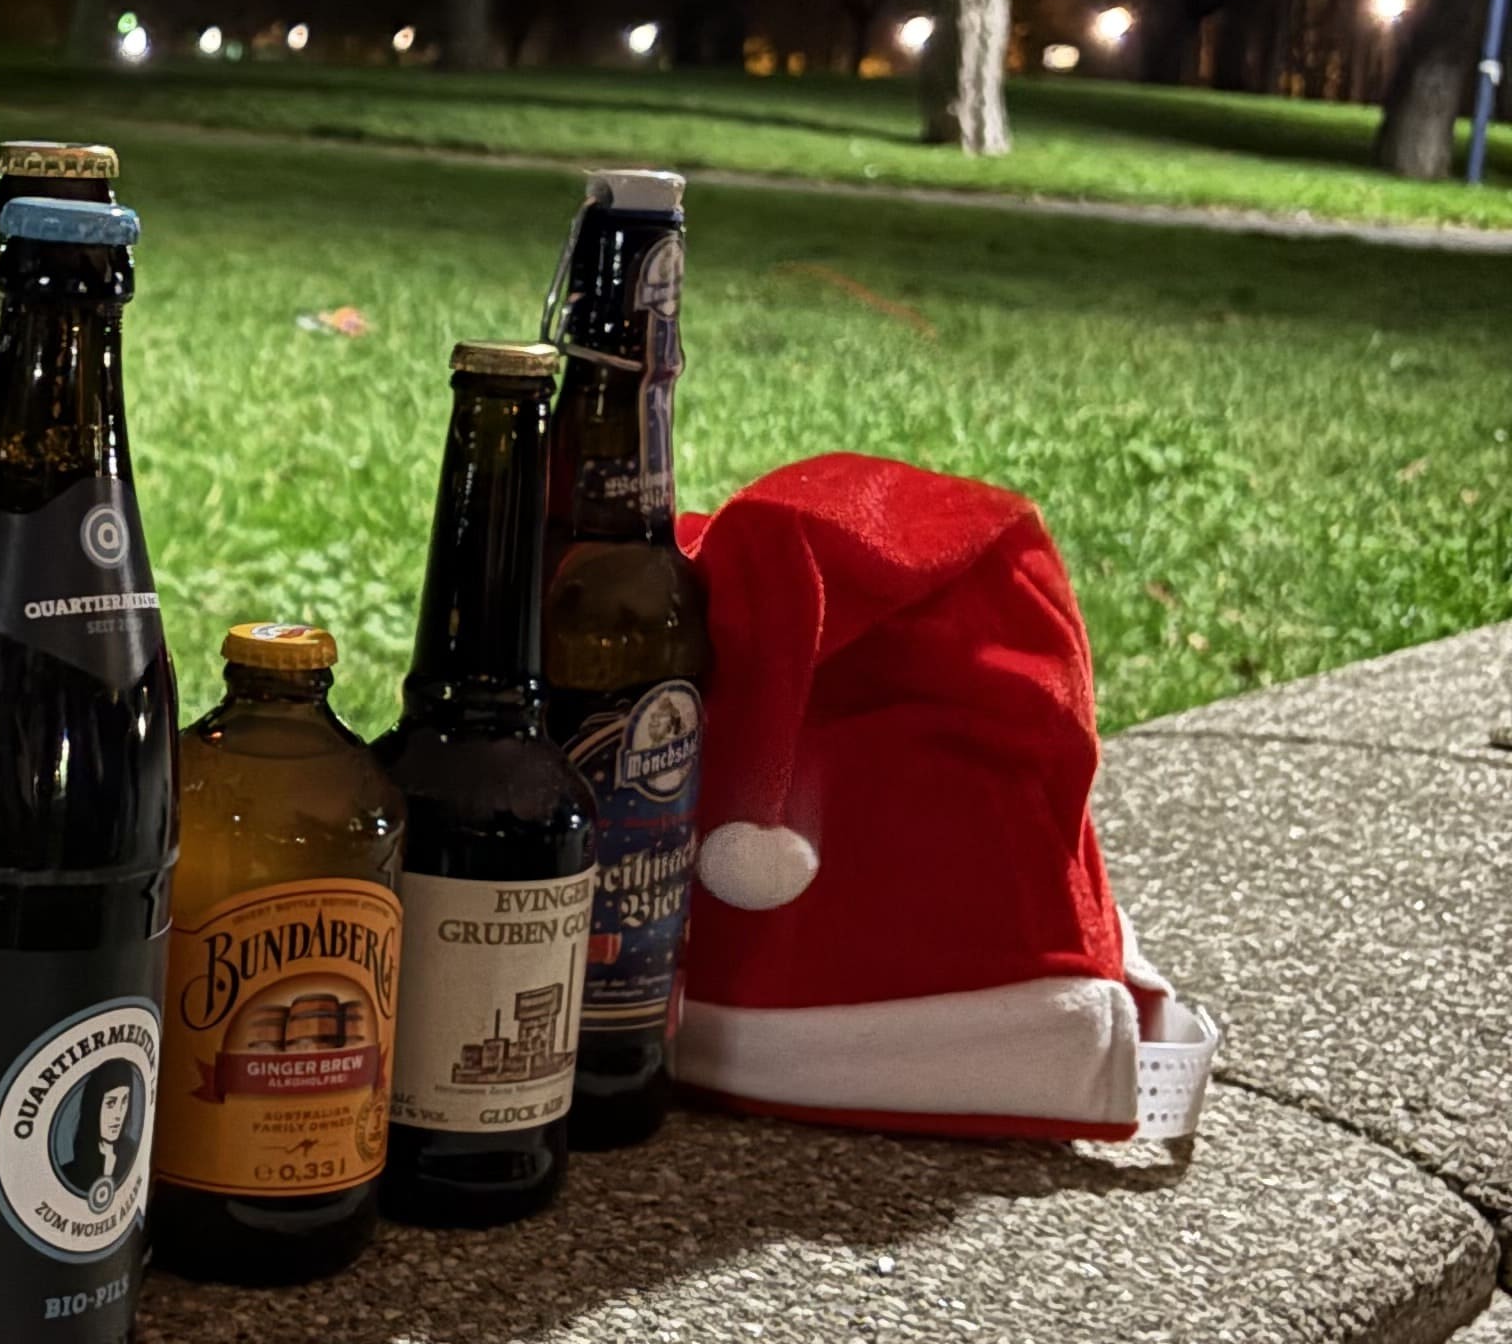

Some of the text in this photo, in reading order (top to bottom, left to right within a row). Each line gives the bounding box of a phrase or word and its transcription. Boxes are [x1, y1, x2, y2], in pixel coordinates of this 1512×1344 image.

[620, 884, 685, 928] Bier
[438, 918, 559, 946] GRUBEN
[180, 909, 396, 1031] BUNDABERG
[247, 1055, 364, 1077] GINGER BREW
[34, 1200, 68, 1233] ZUM
[70, 1215, 118, 1238] WOHLE
[44, 1272, 130, 1319] BIO-PILS
